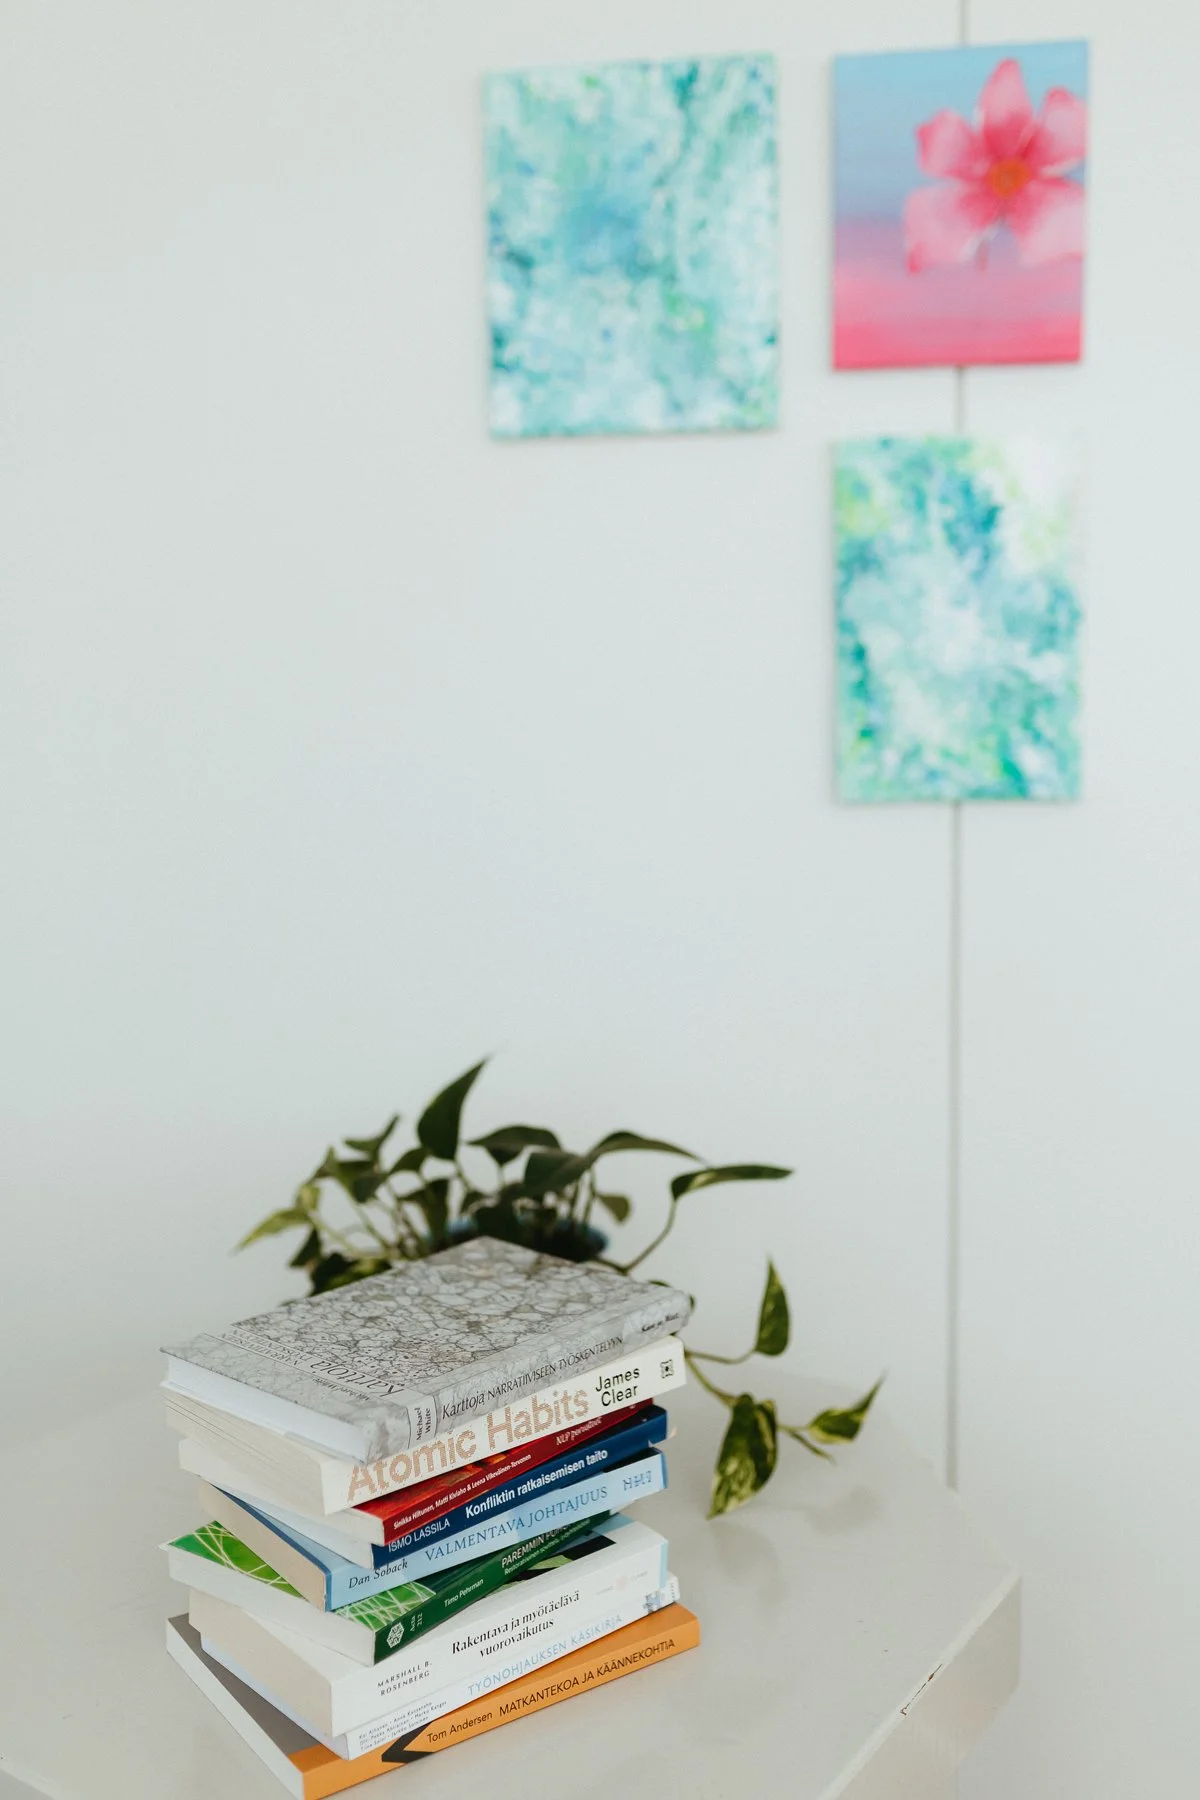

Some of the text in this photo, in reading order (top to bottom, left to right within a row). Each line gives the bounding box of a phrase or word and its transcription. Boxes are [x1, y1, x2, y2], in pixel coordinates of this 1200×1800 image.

[310, 1360, 405, 1397] Karttoja
[442, 1336, 624, 1420] Karttoja NARRATIIVISEEN TYÖSKENTELYYN
[595, 1367, 640, 1392] James
[601, 1385, 638, 1407] Clear
[347, 1389, 590, 1501] Atomic Habits
[465, 1449, 608, 1519] Konfliktin ratkaisemisen taito
[388, 1518, 450, 1552] ISMO LASSILA
[425, 1516, 526, 1561] VALMENTAVA
[528, 1486, 608, 1528] JOHTAJUUS
[501, 1534, 544, 1569] PAREMMIN
[349, 1558, 408, 1589] Dan Soback
[444, 1578, 484, 1608] Timo Pehrman
[452, 1590, 580, 1654] Rakentava ja myötäelävä
[479, 1618, 555, 1657] vuorovaikutus
[377, 1664, 422, 1688] MARSHALL
[380, 1670, 431, 1697] ROSENBERG
[468, 1640, 567, 1696] TYÖNOHJAUKSEN
[427, 1638, 675, 1744] Tom Andersen MATKANTEKOA JA KÄÄNNEKOHTIA
